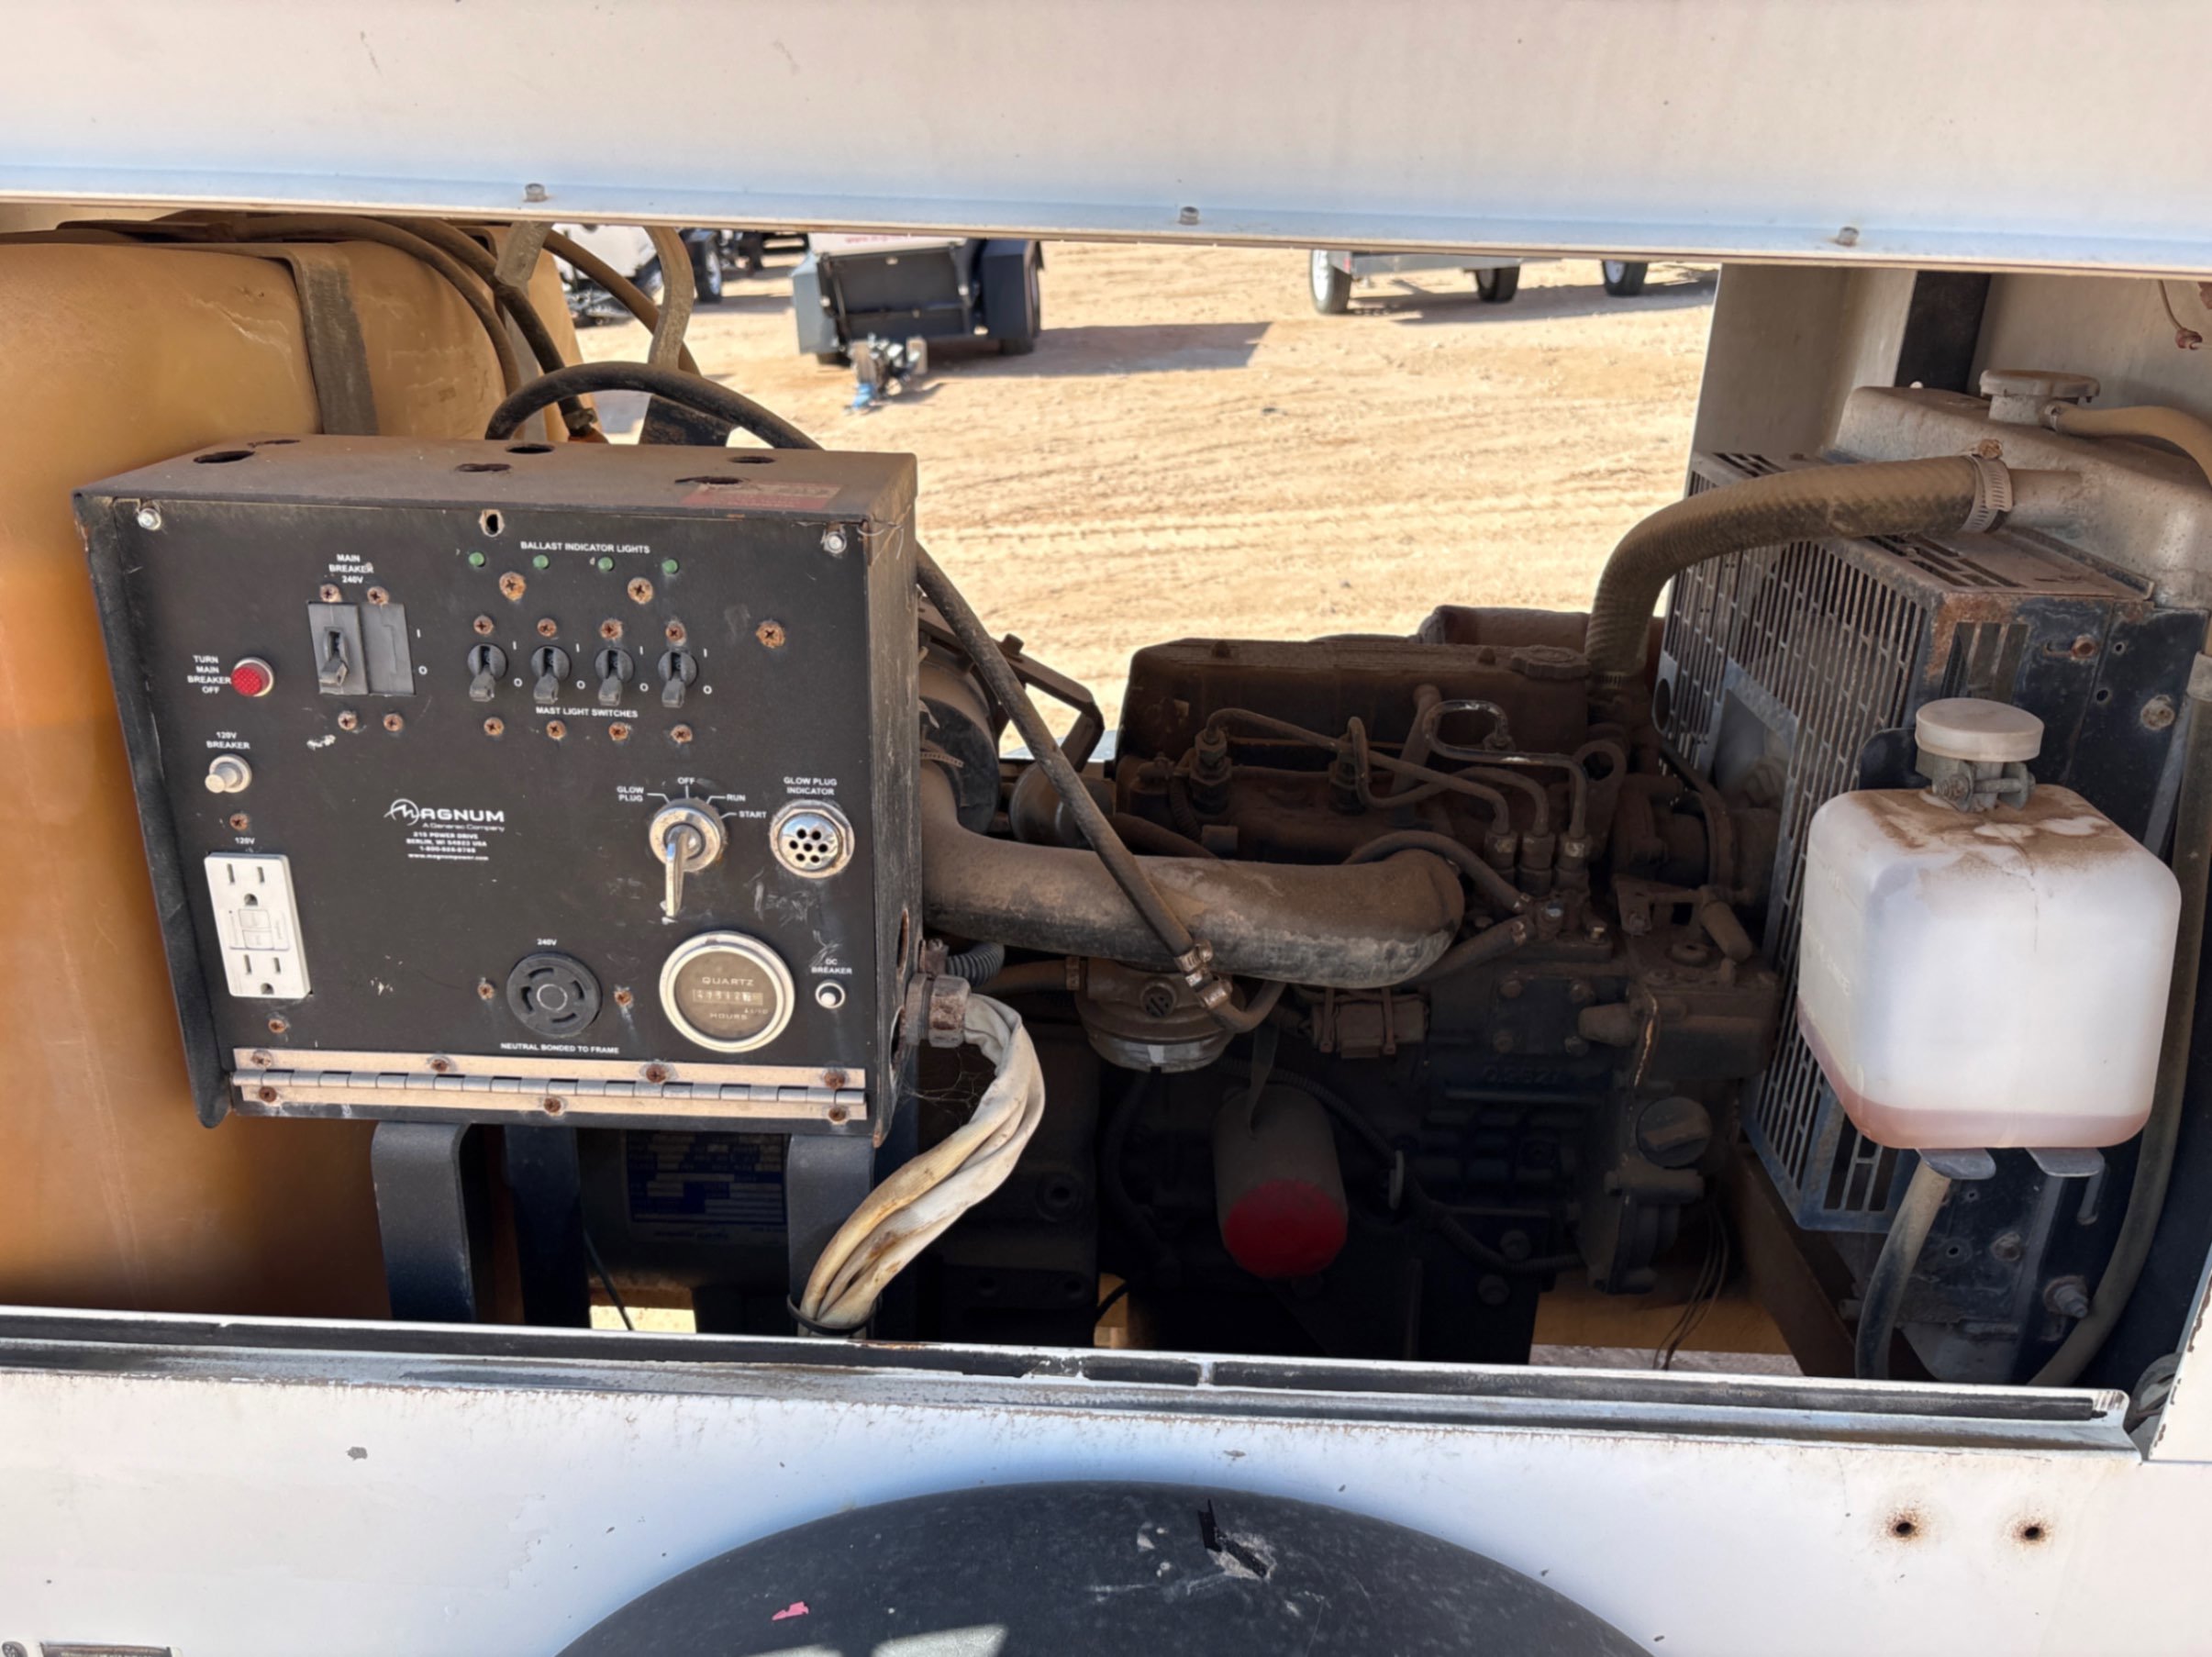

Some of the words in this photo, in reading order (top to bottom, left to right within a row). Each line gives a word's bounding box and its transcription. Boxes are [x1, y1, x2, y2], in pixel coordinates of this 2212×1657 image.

[520, 541, 562, 550] BALLAST
[564, 542, 615, 552] INDICATOR
[617, 544, 651, 554] LIGHTS
[336, 554, 361, 562] MAIN
[328, 563, 374, 574] BREAKER
[341, 575, 363, 584] 240V
[193, 654, 219, 664] TURN
[195, 665, 220, 673] MAIN
[187, 674, 232, 684] BREAKER
[202, 685, 220, 695] OFF
[535, 706, 561, 716] MAST
[562, 707, 590, 717] LIGHT
[591, 707, 639, 718] SWITCHES
[216, 731, 238, 740] 120V
[206, 740, 250, 750] BREAKER
[677, 777, 695, 785] OFF
[783, 776, 811, 786] GLOW
[813, 778, 838, 787] PLUG
[617, 786, 644, 795] GLOW
[786, 786, 835, 796] INDICATOR
[618, 795, 644, 803] PLUG
[726, 794, 746, 803] RUN
[383, 799, 505, 825] MAGNUM
[739, 809, 767, 819] START
[537, 938, 557, 946] 240V
[811, 966, 853, 975] BREAKER
[702, 976, 754, 986] QUARTZ
[710, 1012, 748, 1021] HOURS
[500, 1042, 539, 1051] NEUTRAL
[540, 1044, 576, 1052] BONDED
[590, 1045, 619, 1054] FRAME
